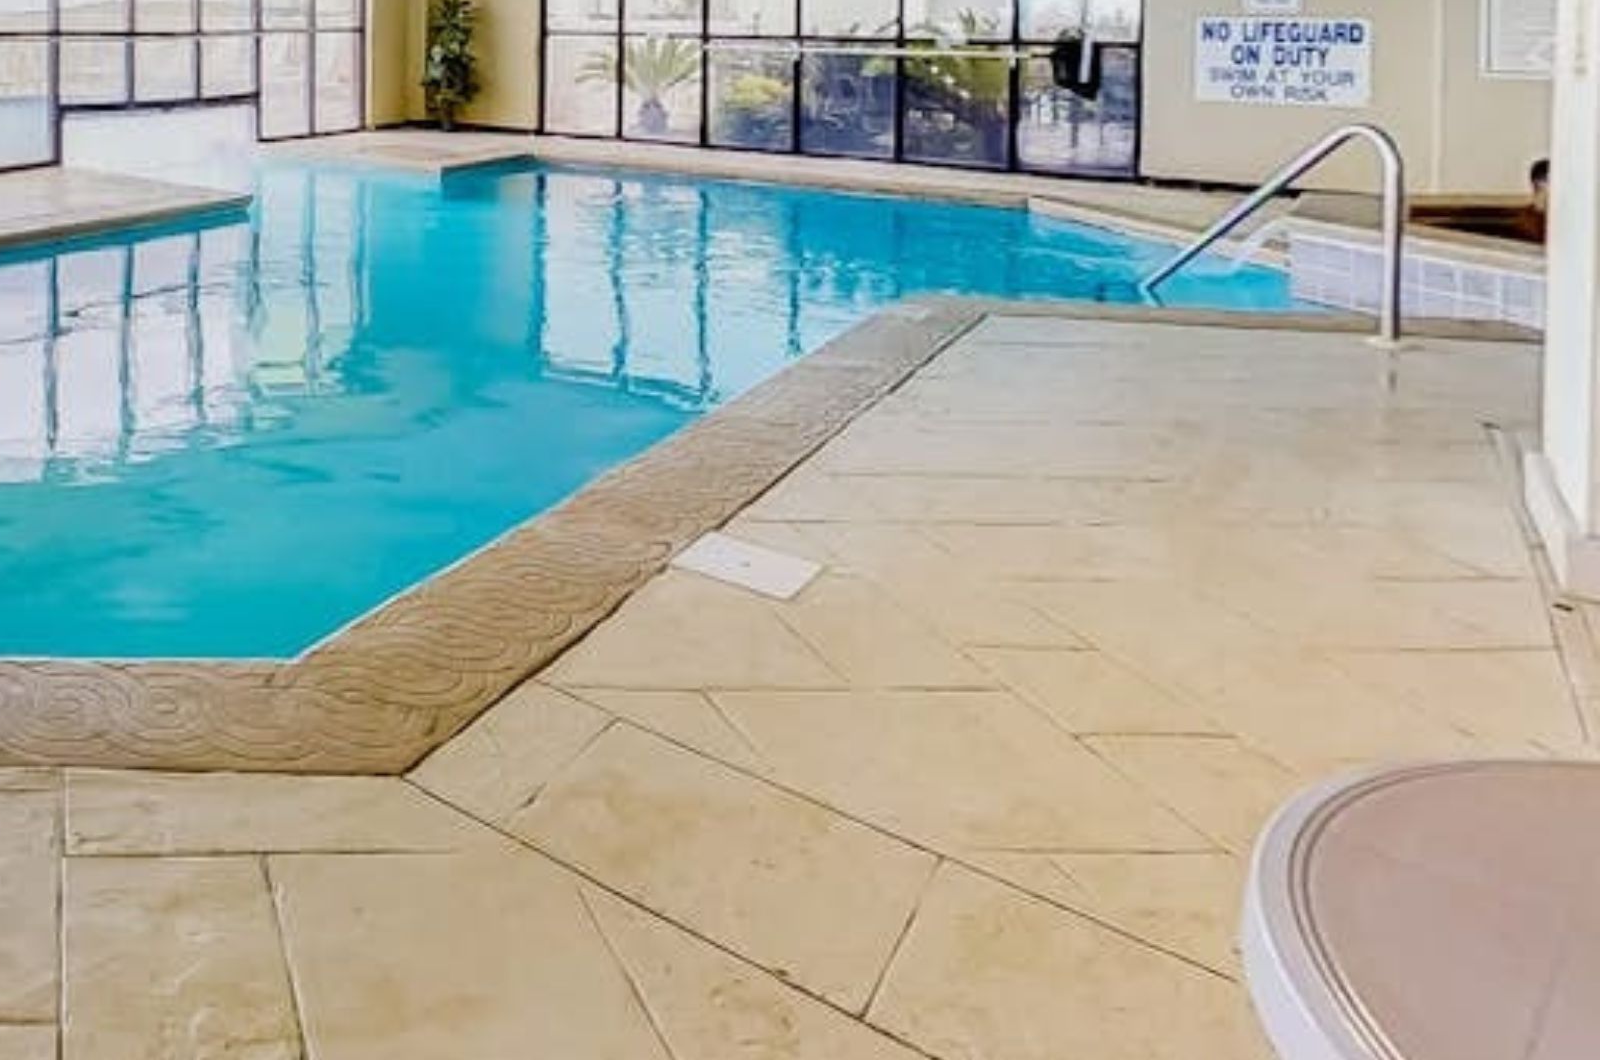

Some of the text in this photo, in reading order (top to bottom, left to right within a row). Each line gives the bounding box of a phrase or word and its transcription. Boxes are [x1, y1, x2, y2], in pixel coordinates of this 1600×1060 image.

[1202, 21, 1364, 43] NO LIFEGUARD
[1231, 45, 1328, 66] ON DUTY
[1209, 67, 1355, 86] SWIM AT YOUR
[1230, 84, 1328, 101] OWN RISK
